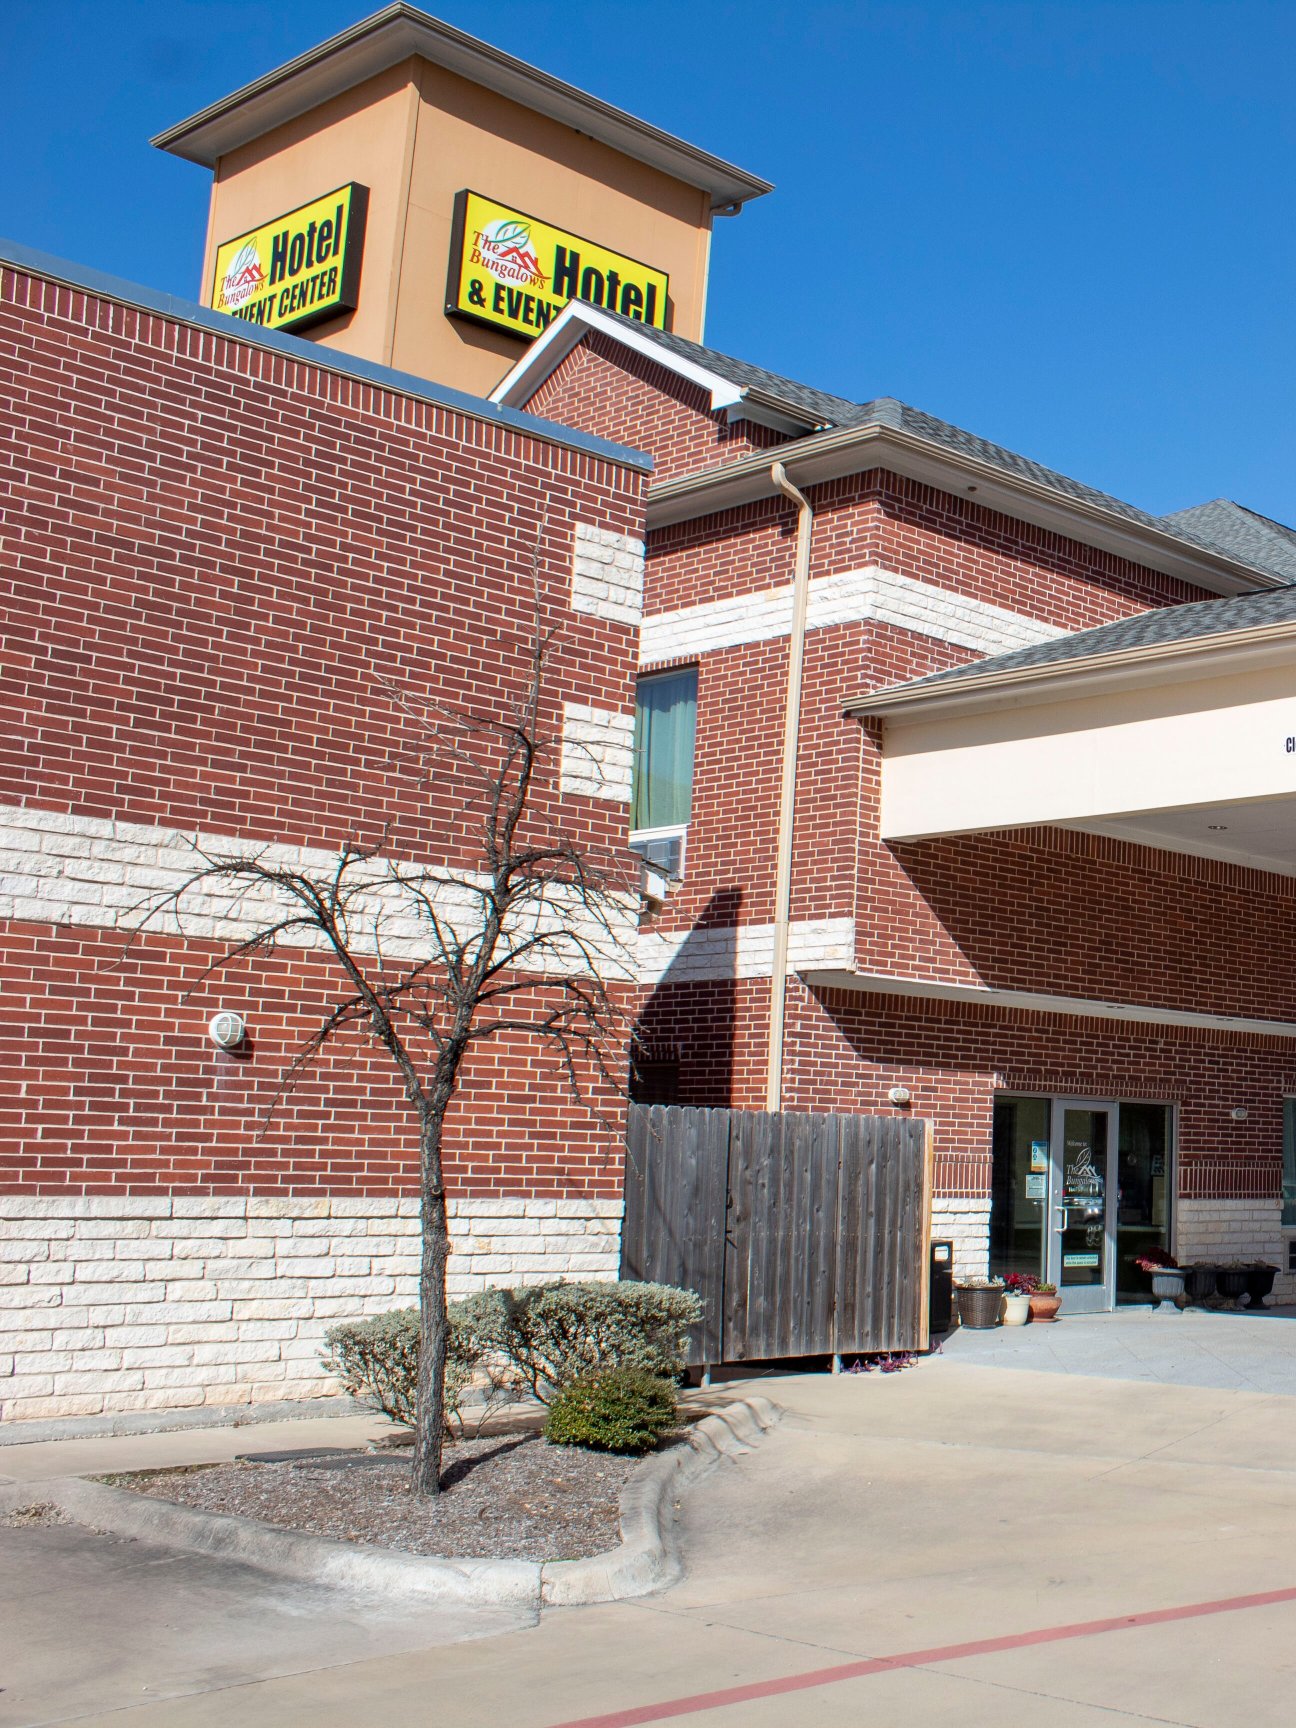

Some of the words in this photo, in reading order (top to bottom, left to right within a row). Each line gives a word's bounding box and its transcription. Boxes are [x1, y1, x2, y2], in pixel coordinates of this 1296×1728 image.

[269, 203, 344, 287] Hotel
[472, 230, 500, 254] The
[219, 275, 237, 292] The
[469, 247, 546, 290] Bungalows
[552, 244, 657, 327] Hotel
[217, 281, 264, 308] Bungalows
[231, 293, 278, 326] ENT
[277, 265, 338, 318] CENTER
[468, 278, 487, 309] &
